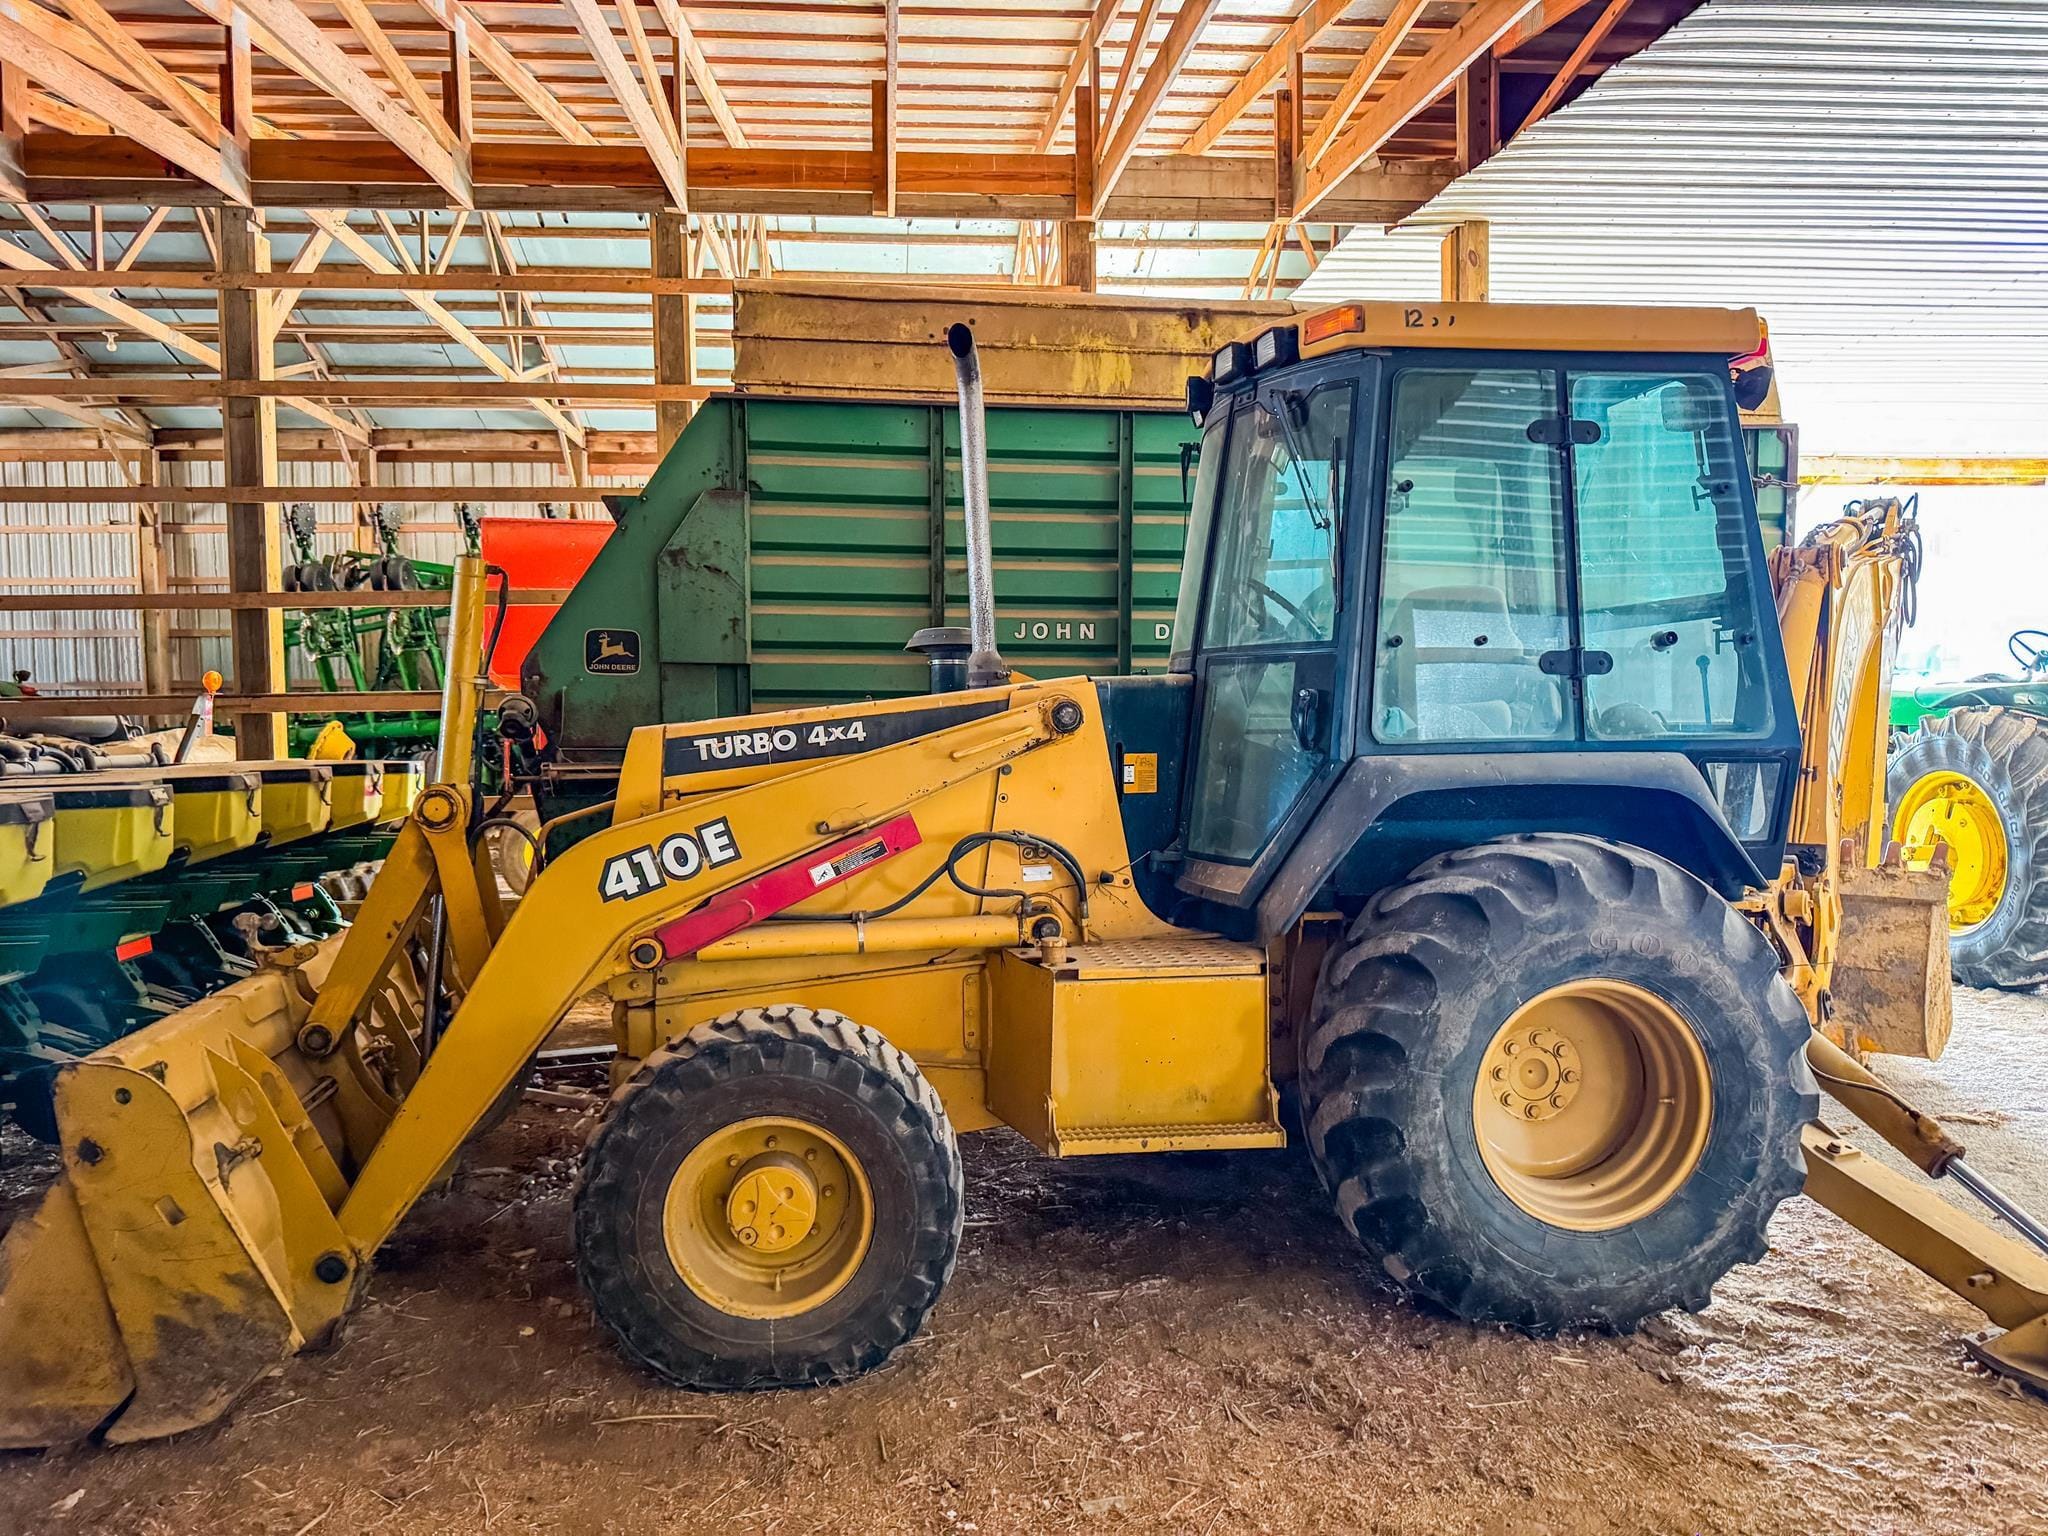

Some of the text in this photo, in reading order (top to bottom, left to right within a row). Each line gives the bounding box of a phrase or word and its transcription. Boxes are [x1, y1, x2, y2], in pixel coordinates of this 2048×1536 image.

[1013, 622, 1096, 641] JOHN
[588, 663, 637, 671] JOHN DEERE
[693, 720, 868, 761] TURBO 4x4
[601, 819, 739, 900] 410E
